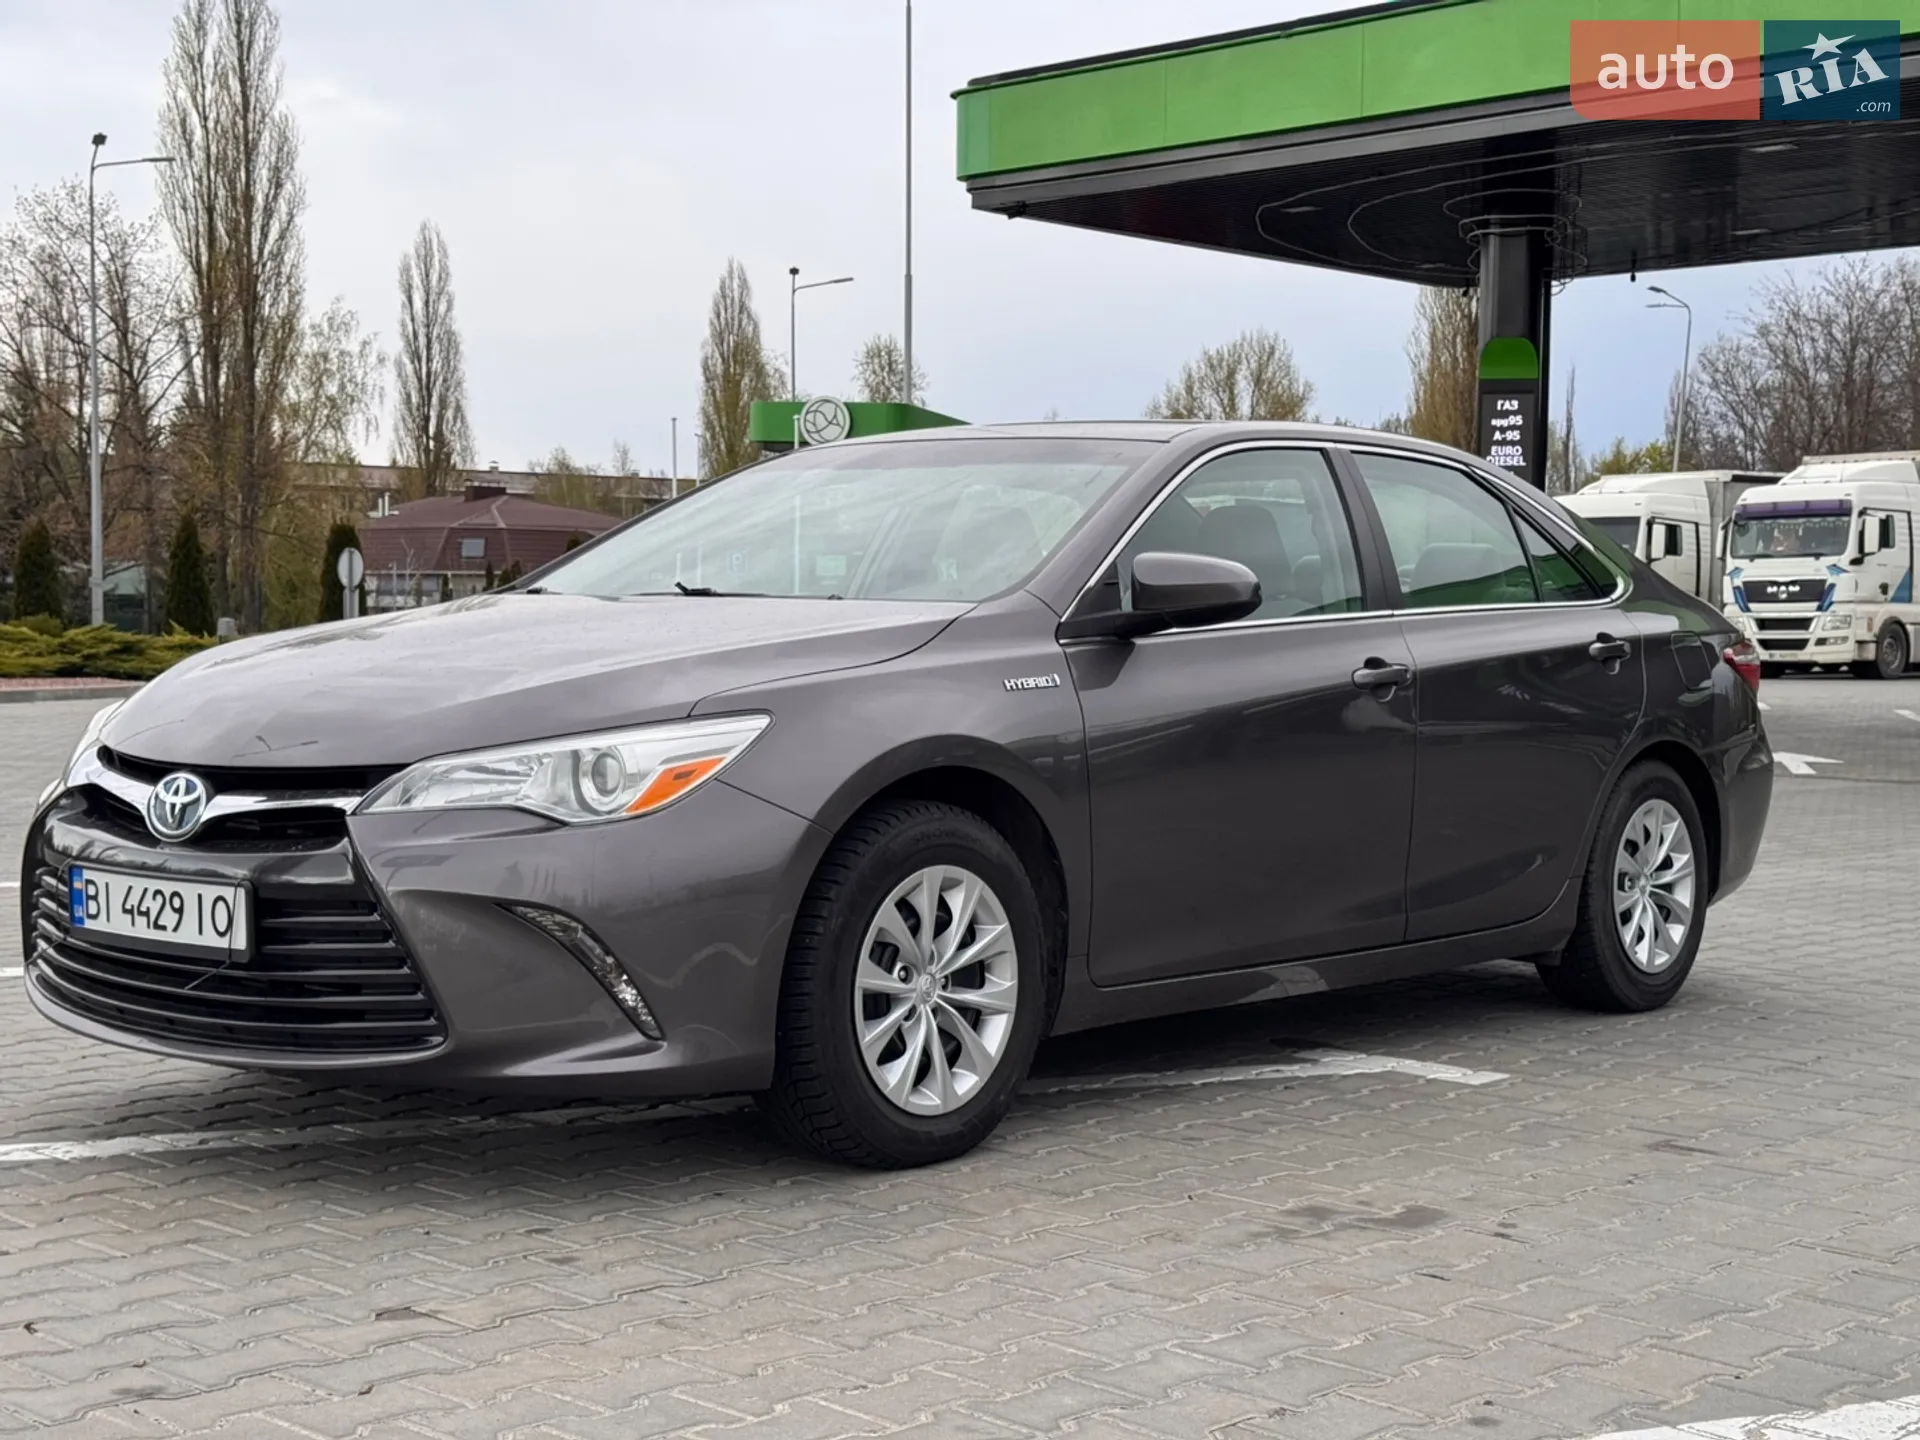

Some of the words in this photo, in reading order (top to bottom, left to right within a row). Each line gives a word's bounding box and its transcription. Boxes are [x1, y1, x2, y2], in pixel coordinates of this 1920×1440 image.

[1497, 399, 1519, 411] ГАЗ
[1491, 445, 1523, 456] EURO
[1002, 676, 1052, 691] HYBRID
[121, 885, 184, 933] 4429
